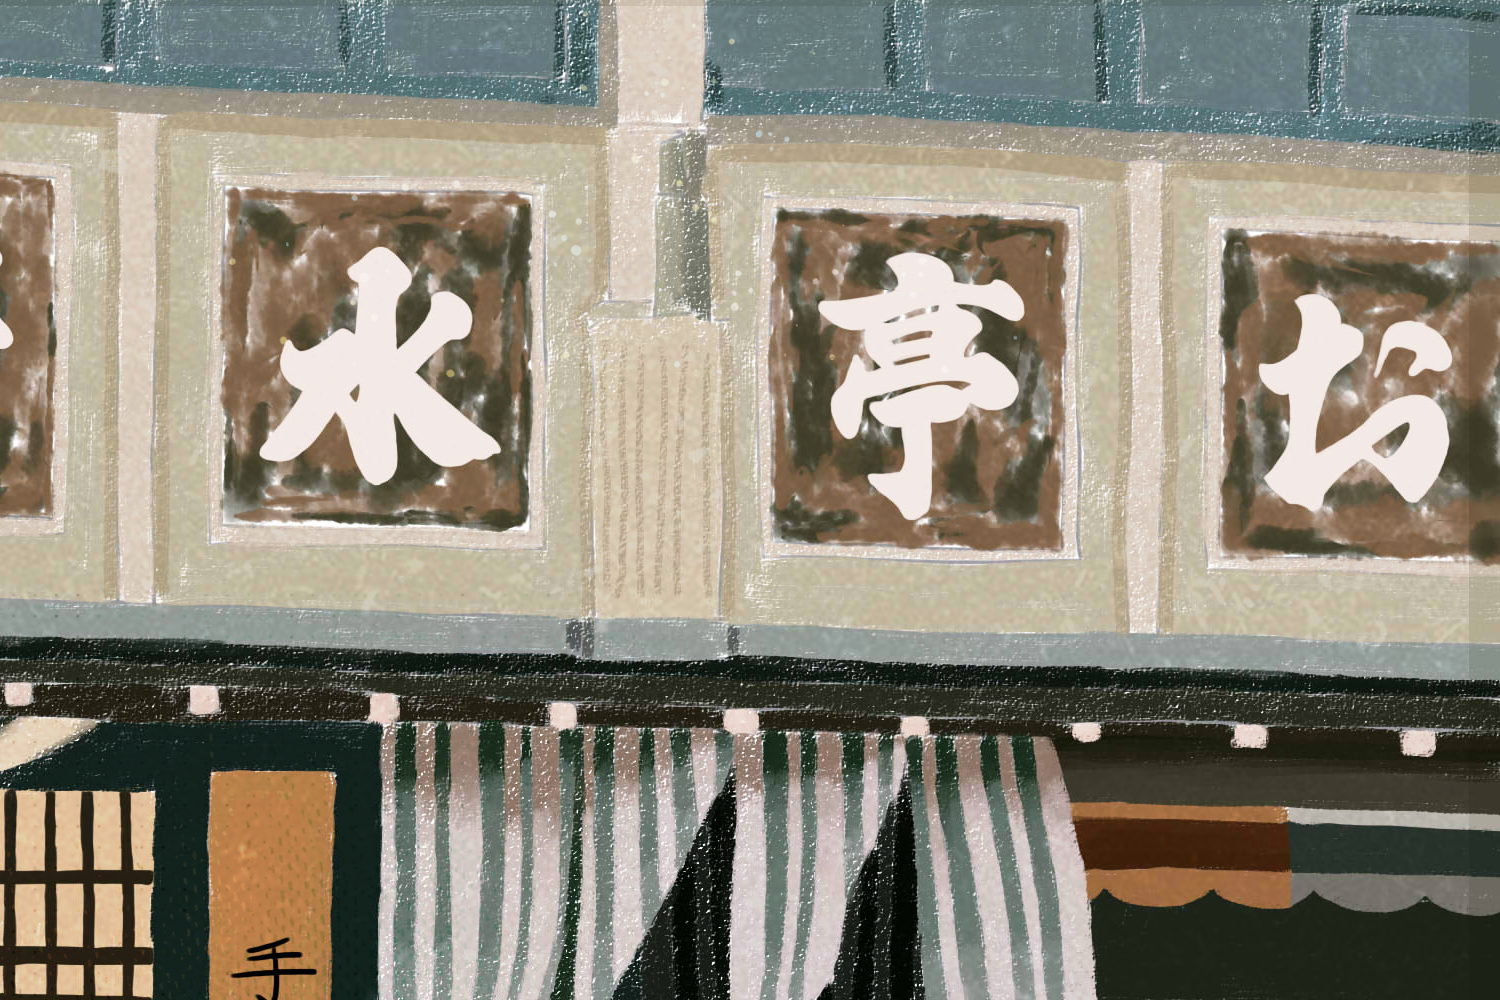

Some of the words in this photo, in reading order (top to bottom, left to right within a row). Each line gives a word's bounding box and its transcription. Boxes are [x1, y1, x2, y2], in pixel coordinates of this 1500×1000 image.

[260, 247, 501, 486] 水
[818, 252, 1025, 521] 亭
[1258, 294, 1453, 512] お
